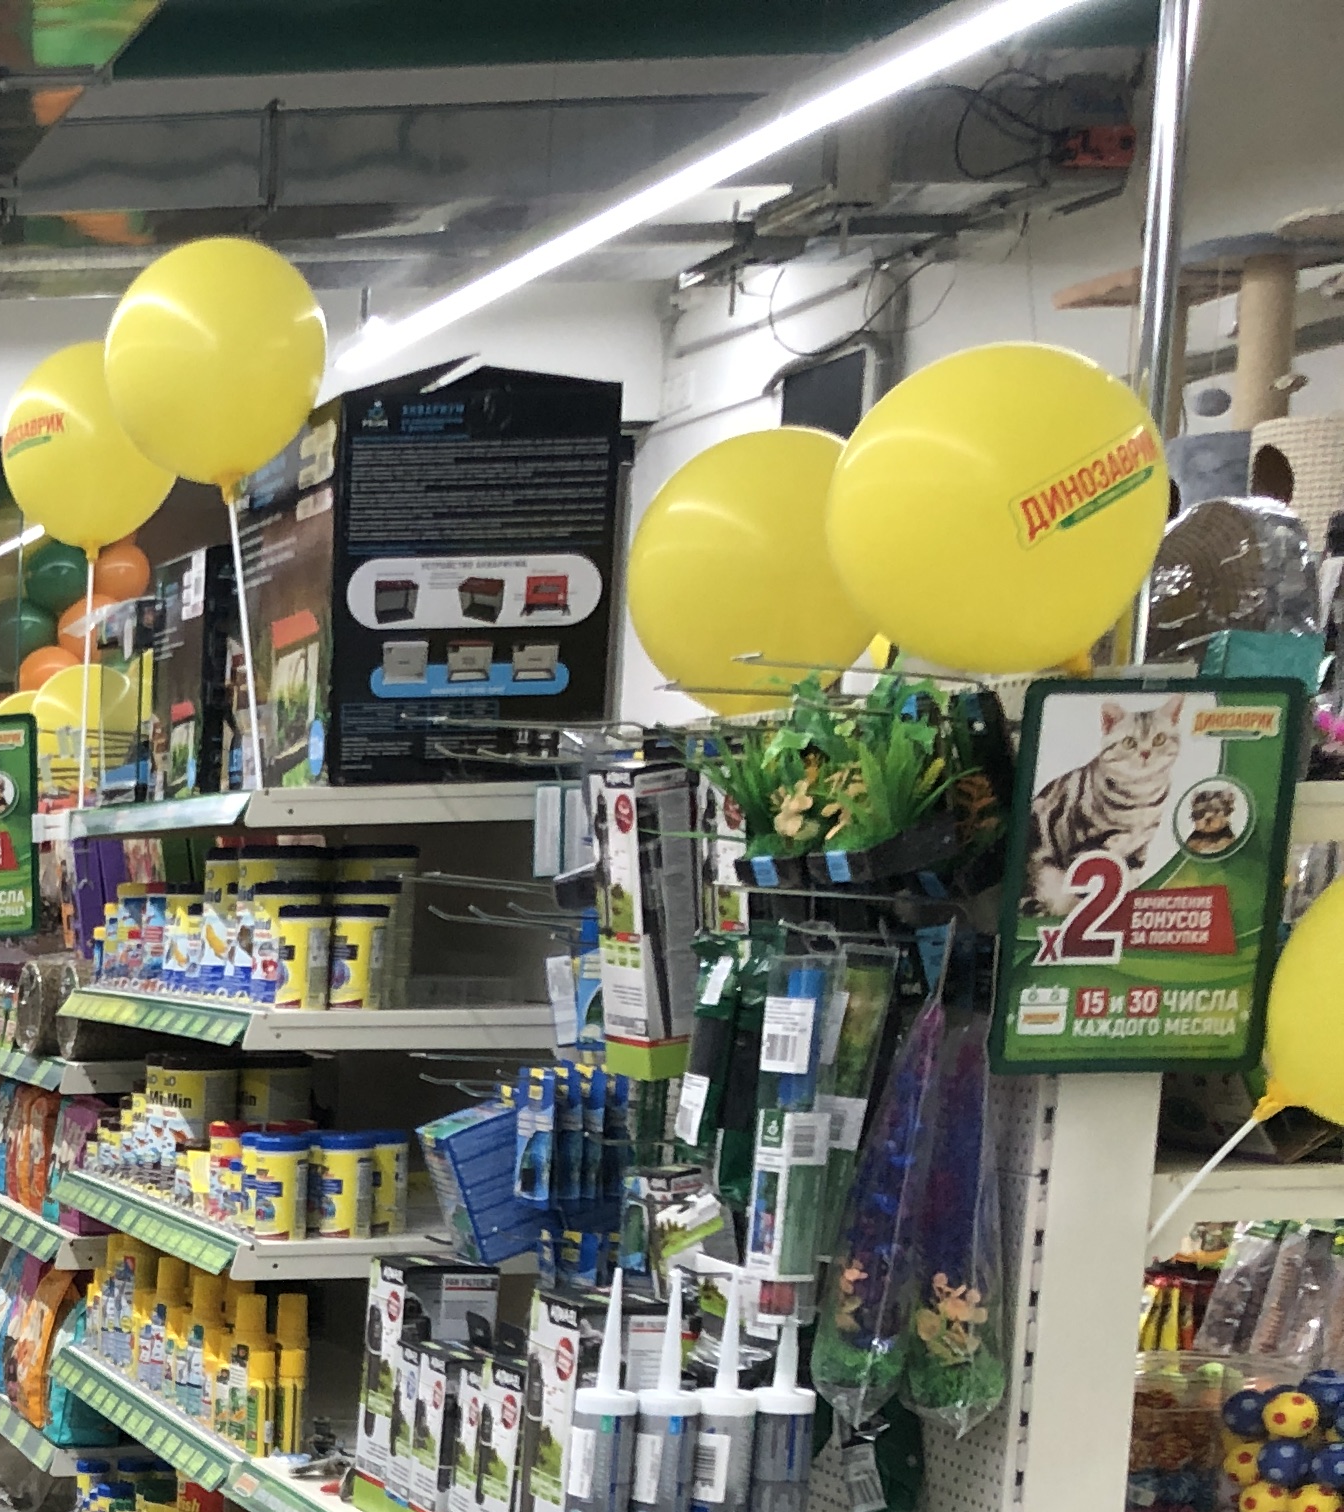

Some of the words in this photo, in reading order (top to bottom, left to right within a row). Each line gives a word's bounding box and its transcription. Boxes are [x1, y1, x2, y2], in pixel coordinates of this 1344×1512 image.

[1194, 711, 1275, 732] ДИНОЗАВРИК
[1133, 895, 1213, 909] НАЧИСЛЕНИЕ
[1131, 911, 1212, 929] БОНУСОВ
[1130, 931, 1147, 945] ЗА
[1149, 930, 1210, 945] ПОКУПКИ
[1080, 990, 1104, 1013] 15
[1128, 990, 1159, 1013] 30
[1163, 988, 1239, 1013] ЧИСЛА
[1072, 1018, 1160, 1038] КАЖДОГО
[1163, 1017, 1237, 1036] МЕСЯЦА
